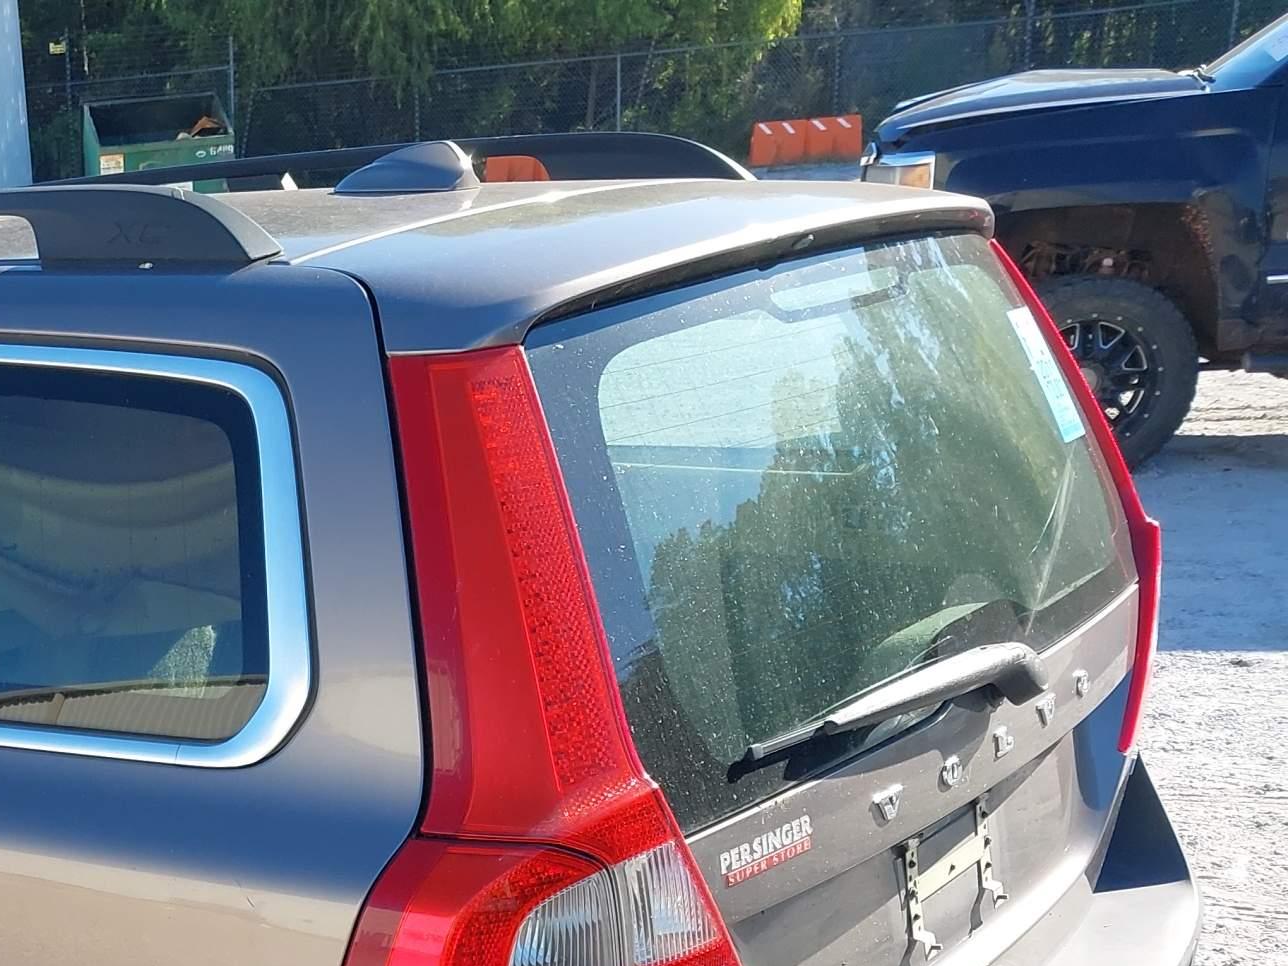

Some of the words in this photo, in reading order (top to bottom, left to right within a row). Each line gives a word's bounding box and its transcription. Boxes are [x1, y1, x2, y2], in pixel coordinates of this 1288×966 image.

[872, 669, 1090, 821] VOLVO
[720, 814, 813, 875] PERSINGER
[728, 859, 768, 887] SUPER
[772, 838, 810, 866] STORE
